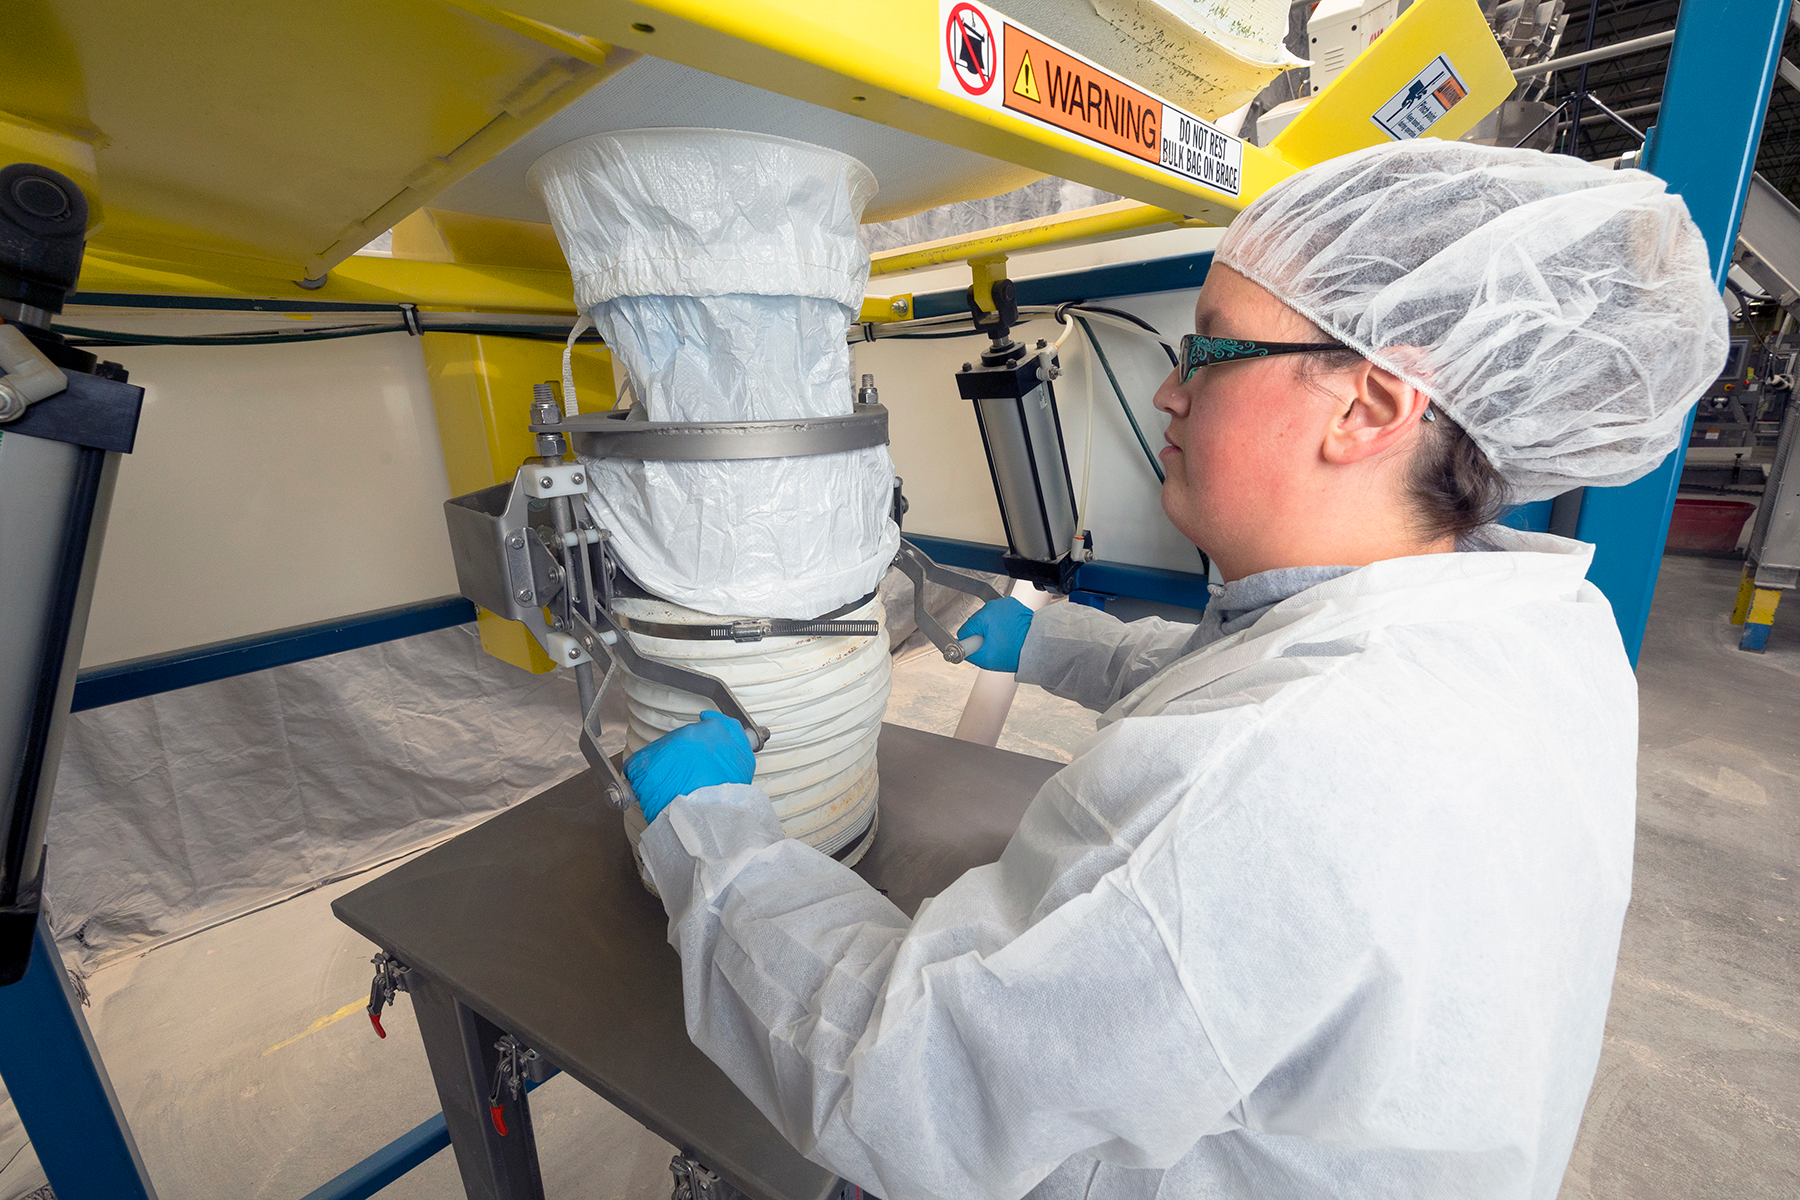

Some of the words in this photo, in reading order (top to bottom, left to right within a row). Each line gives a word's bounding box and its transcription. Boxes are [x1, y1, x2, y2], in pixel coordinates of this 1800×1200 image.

[1046, 60, 1156, 149] WARNING
[1406, 113, 1415, 122] Keep
[1411, 118, 1420, 127] hands
[1416, 124, 1425, 132] clear
[1419, 101, 1431, 115] Pinch
[1180, 117, 1191, 145] DO
[1193, 124, 1208, 152] NOT
[1210, 132, 1227, 160] REST
[1162, 137, 1184, 170] BULK
[1186, 148, 1201, 176] BAG
[1203, 156, 1214, 180] ON
[1215, 161, 1237, 190] BRACE
